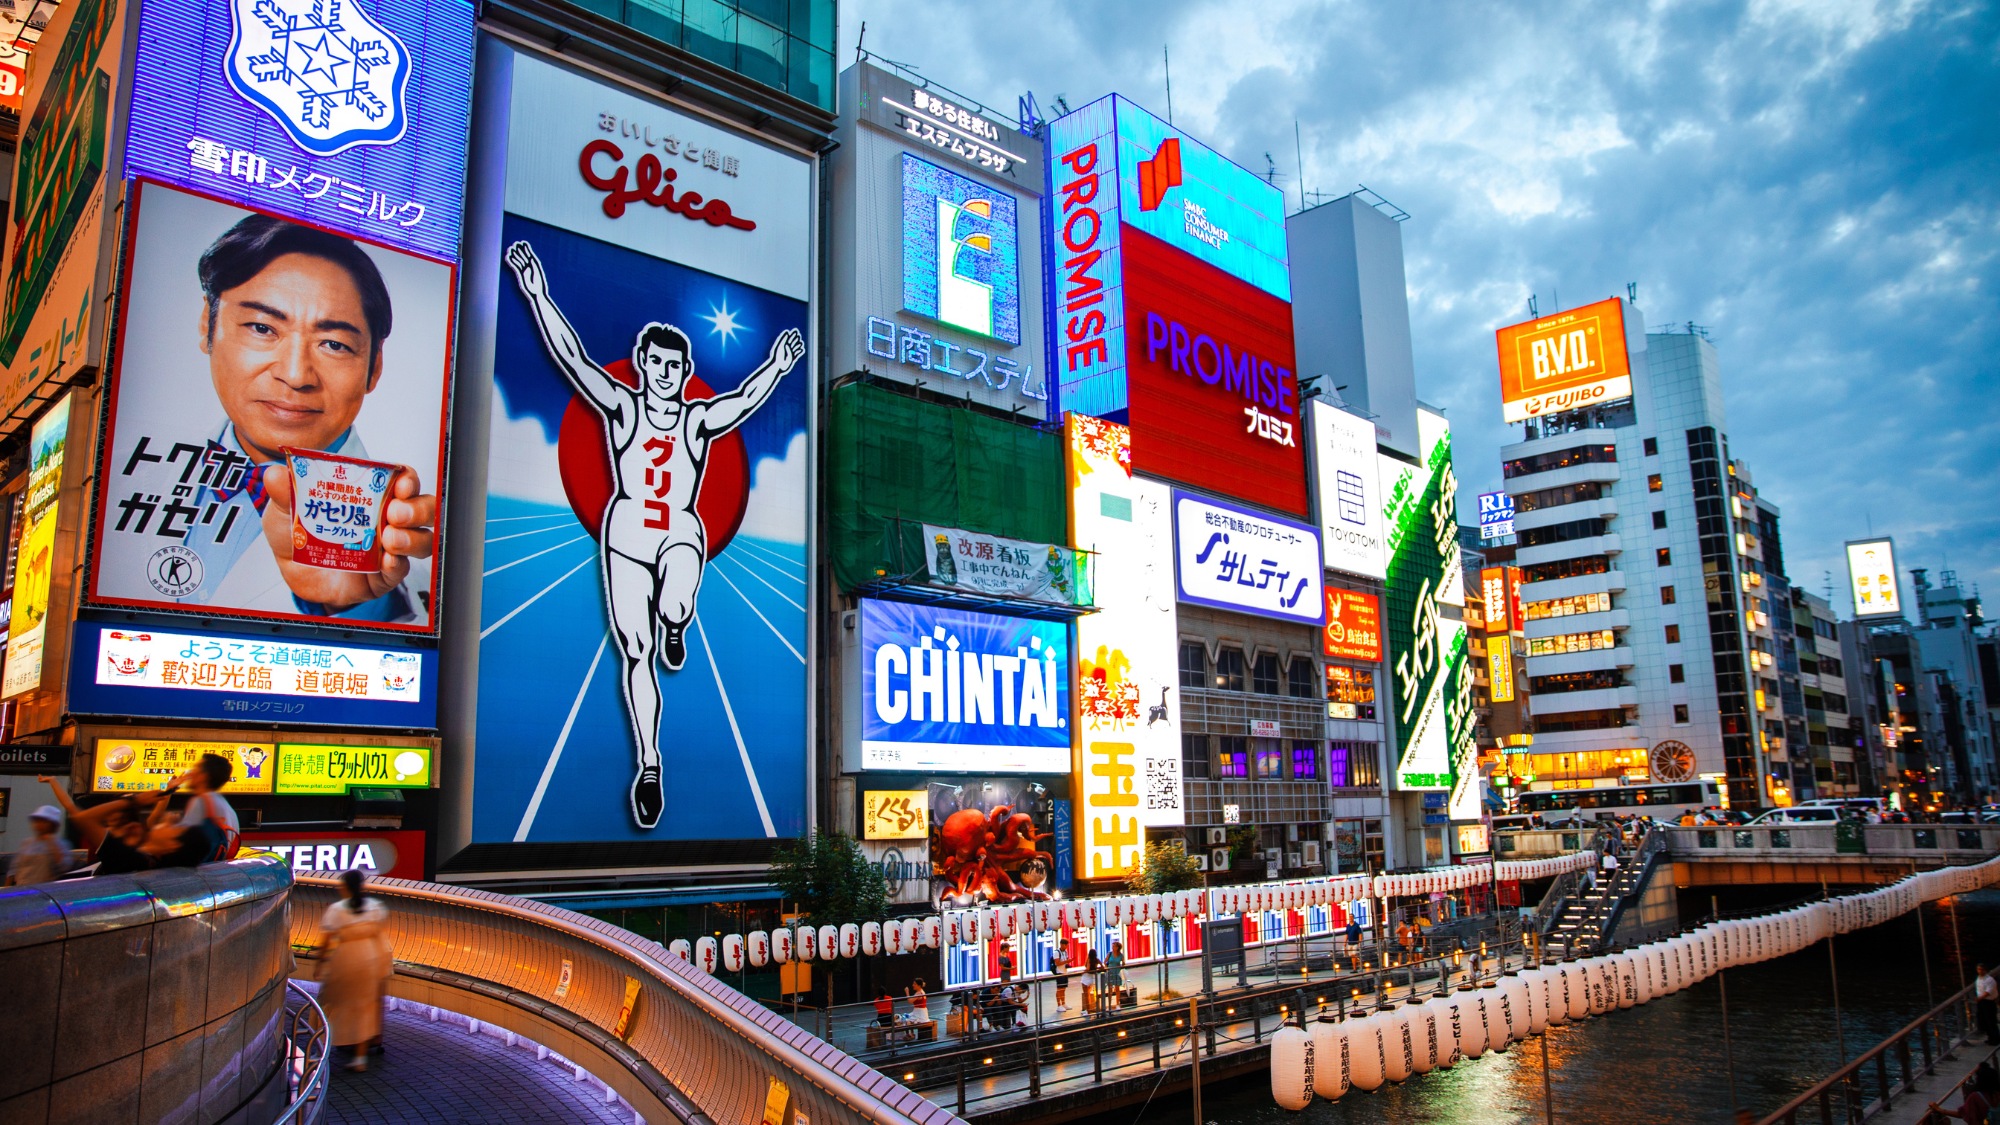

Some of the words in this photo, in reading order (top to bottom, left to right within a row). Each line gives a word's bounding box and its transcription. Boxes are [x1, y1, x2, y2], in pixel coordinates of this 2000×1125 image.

[912, 89, 1000, 141] 夢ある住まい
[599, 110, 740, 178] おいしさと健康
[906, 117, 1007, 172] エステムプラザ
[187, 135, 426, 227] 雪印メグミルク
[579, 138, 757, 232] Glico
[1183, 198, 1207, 220] SMBC
[1184, 210, 1230, 243] CONSUMER
[1185, 222, 1222, 250] FINANCE
[1061, 143, 1109, 372] PROMISE
[1536, 320, 1557, 331] Since
[868, 315, 1049, 401] 日商エステム
[1147, 310, 1293, 416] PROMISE
[1531, 329, 1596, 381] B.V.D.
[1544, 385, 1605, 408] FUJIBO
[1243, 405, 1296, 448] プロミス
[122, 437, 248, 490] トクホ
[332, 464, 348, 480] 恵
[171, 485, 193, 497] の
[308, 487, 373, 507] 減らすのを助ける
[316, 480, 364, 496] 内臓脂肪を
[642, 434, 677, 532] グリコ
[114, 491, 241, 544] ガセリ
[315, 524, 358, 539] ヨーグルト
[1205, 511, 1302, 545] 総合不動産のプロデューサー
[339, 560, 358, 569] 100g
[957, 538, 1033, 568] 改源看板
[960, 559, 1036, 581] 工事中でんねん。
[1216, 550, 1291, 593] サムティ
[1491, 577, 1506, 622] カラオケ
[179, 639, 355, 669] ようこそ道頓堀へ
[1395, 577, 1441, 725] エイブル
[295, 669, 369, 696] 道頓堀
[1491, 654, 1504, 699] ネットルーム
[222, 699, 306, 715] 雪印メグミルク
[1089, 715, 1136, 732] スーパー
[143, 747, 235, 762] 店舗情館
[282, 752, 325, 776] 賃貸・売買
[327, 751, 389, 780] ピタットハウス
[116, 781, 155, 791] 株式会社
[877, 797, 916, 832] くくる
[1047, 798, 1054, 825] 2F
[1089, 741, 1140, 878] 玉出
